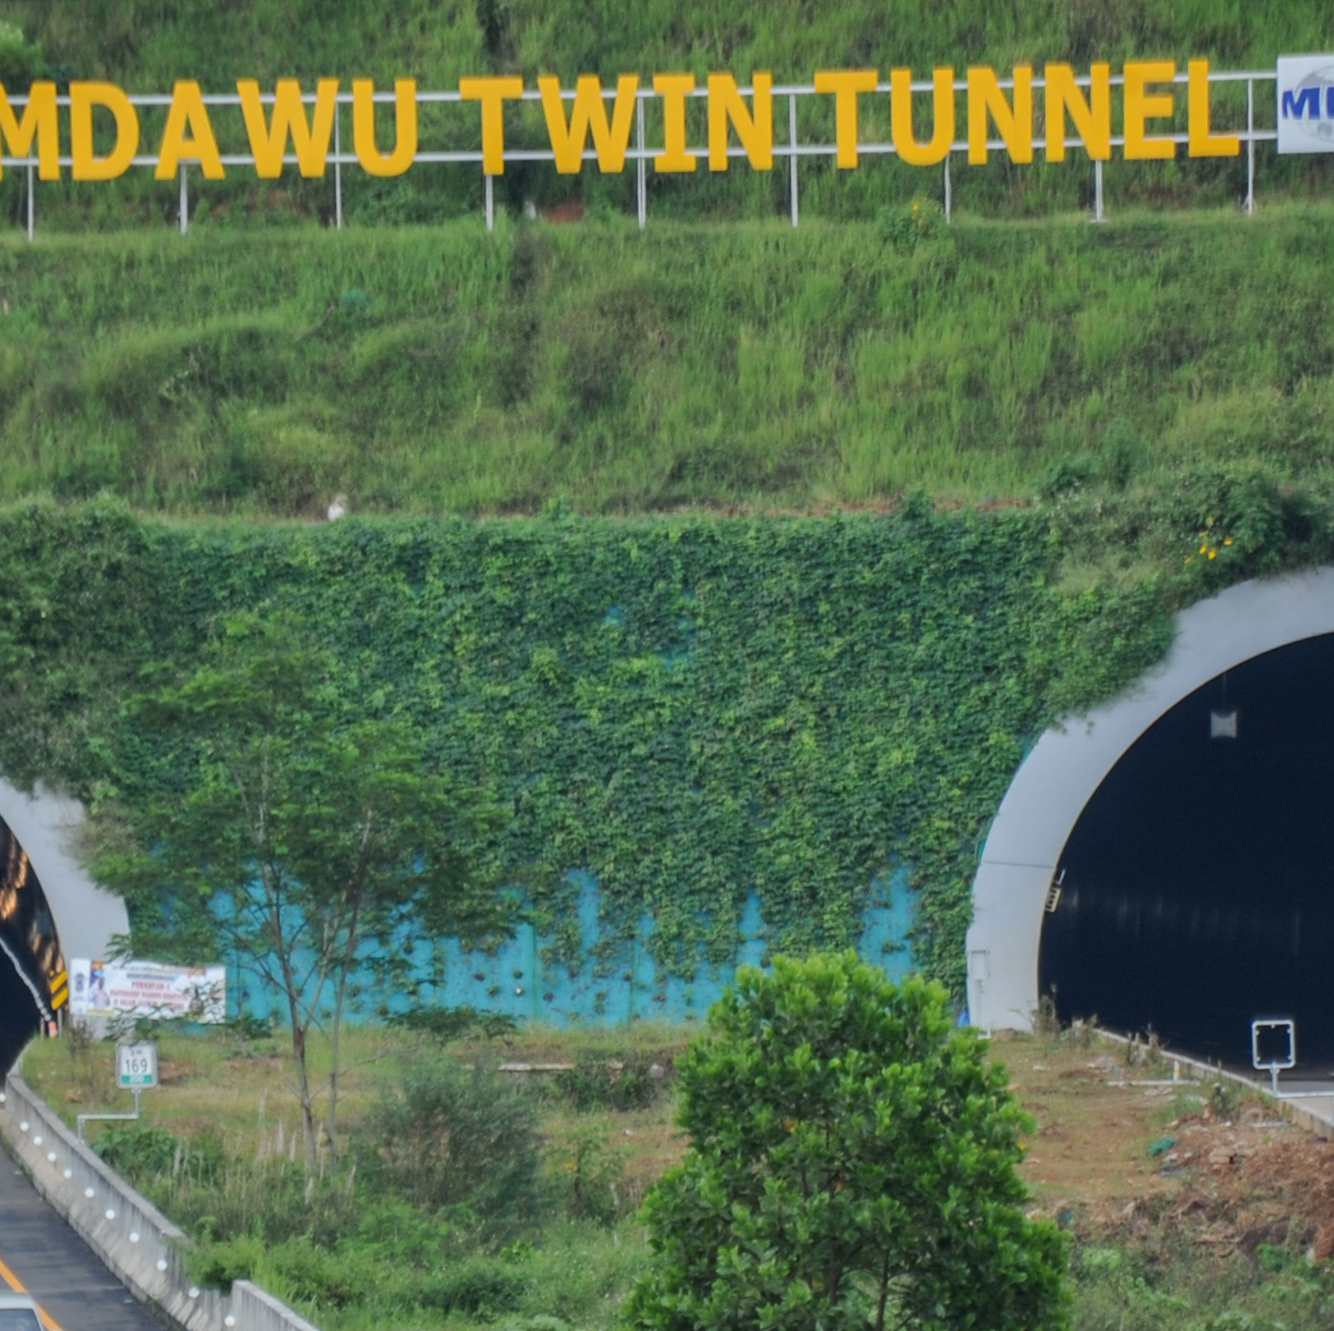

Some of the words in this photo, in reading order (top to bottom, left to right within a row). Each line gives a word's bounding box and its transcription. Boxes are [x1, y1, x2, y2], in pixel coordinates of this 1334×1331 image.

[460, 73, 772, 174] TWIN
[815, 61, 1239, 168] TUNNEL
[125, 1058, 148, 1073] 169
